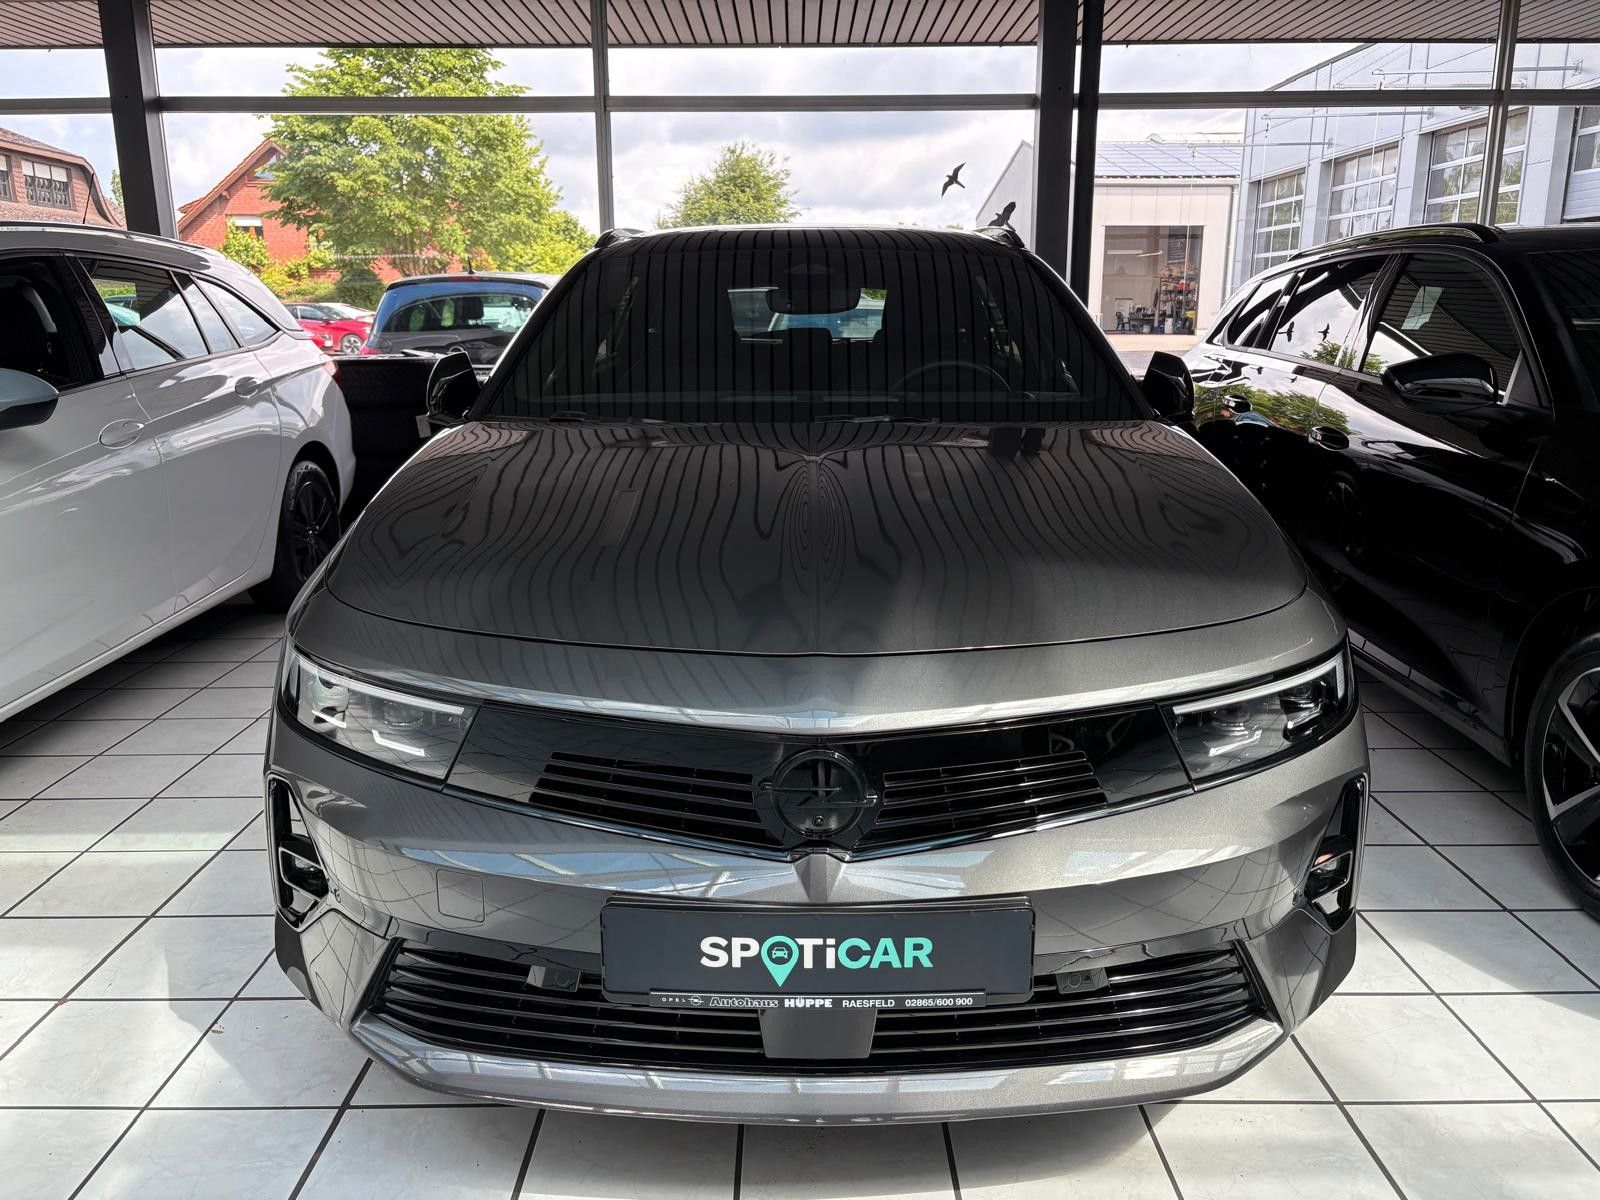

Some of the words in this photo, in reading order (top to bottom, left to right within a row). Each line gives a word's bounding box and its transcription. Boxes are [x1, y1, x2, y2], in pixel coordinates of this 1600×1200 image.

[709, 997, 779, 1008] Autohaus
[784, 996, 833, 1008] HÜPPE
[842, 999, 895, 1008] RAESFELD
[905, 998, 953, 1007] 02865/600
[955, 997, 973, 1005] 900
